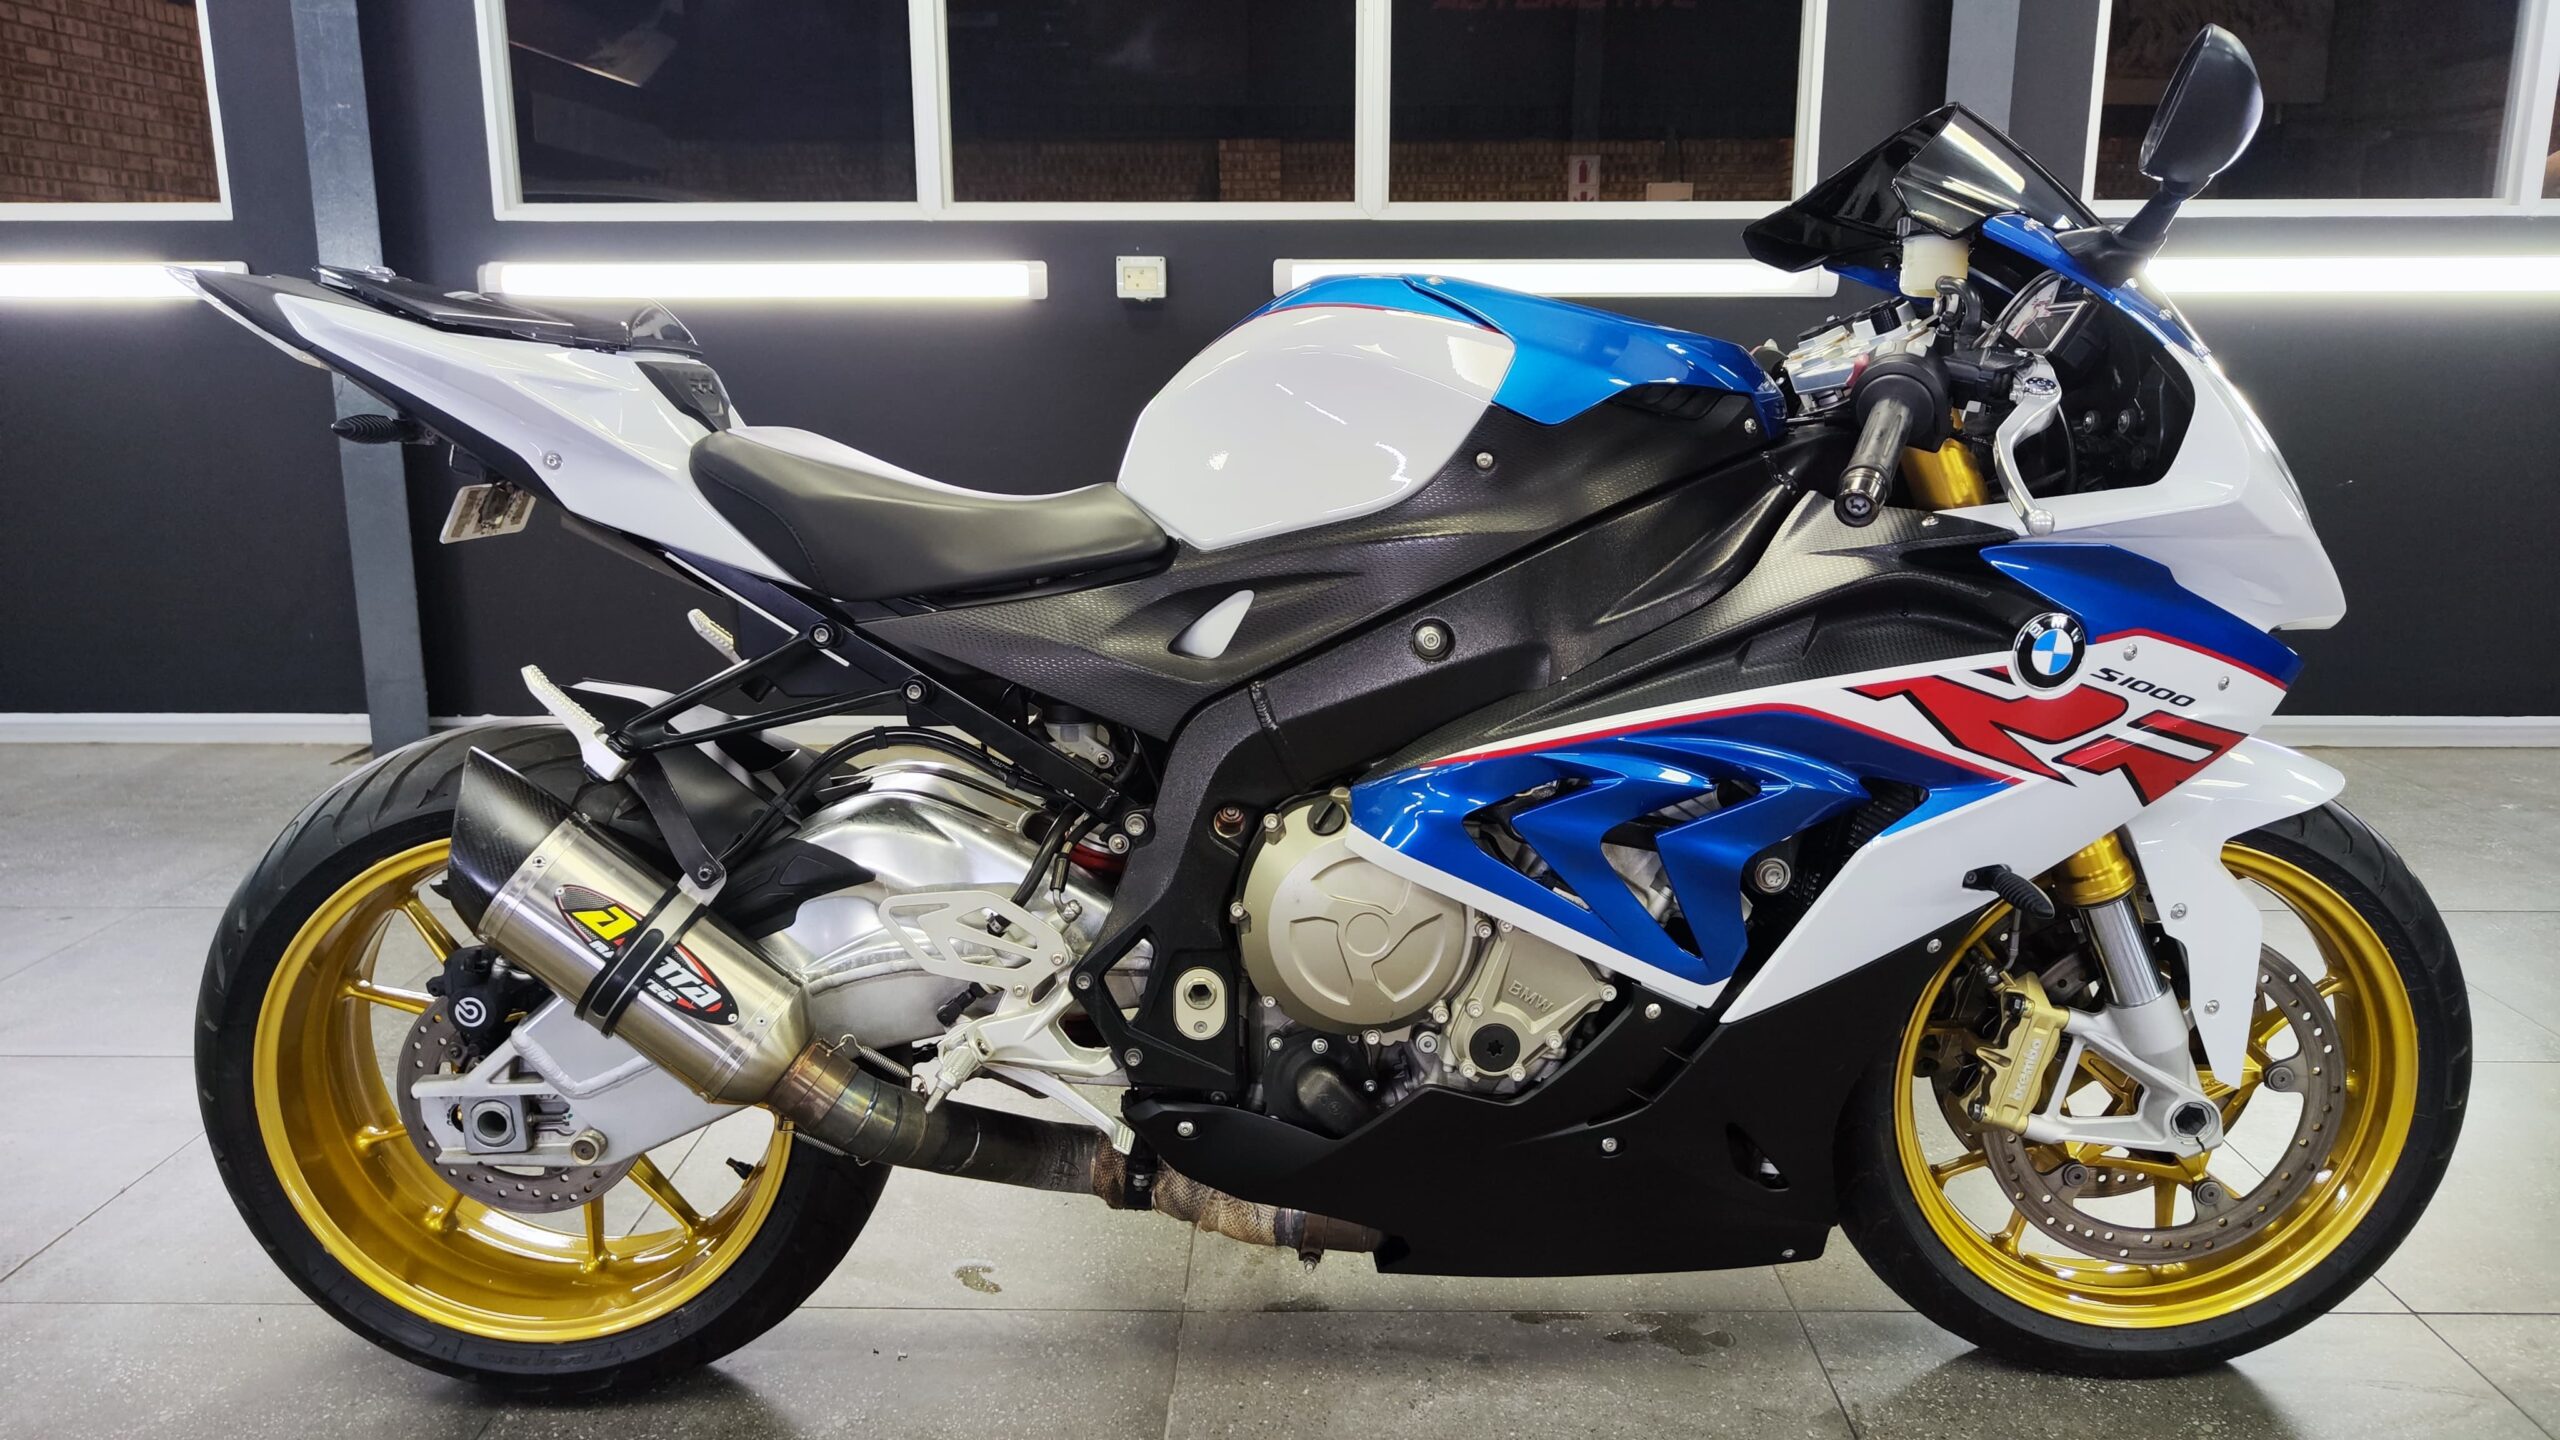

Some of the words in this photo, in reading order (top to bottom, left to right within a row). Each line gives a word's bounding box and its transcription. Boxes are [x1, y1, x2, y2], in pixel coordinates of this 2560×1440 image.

[2028, 615, 2083, 644] BMW
[2090, 667, 2196, 707] S1000
[1842, 666, 2250, 807] RR
[1508, 979, 1554, 1013] BMW
[2007, 1037, 2043, 1102] brembo
